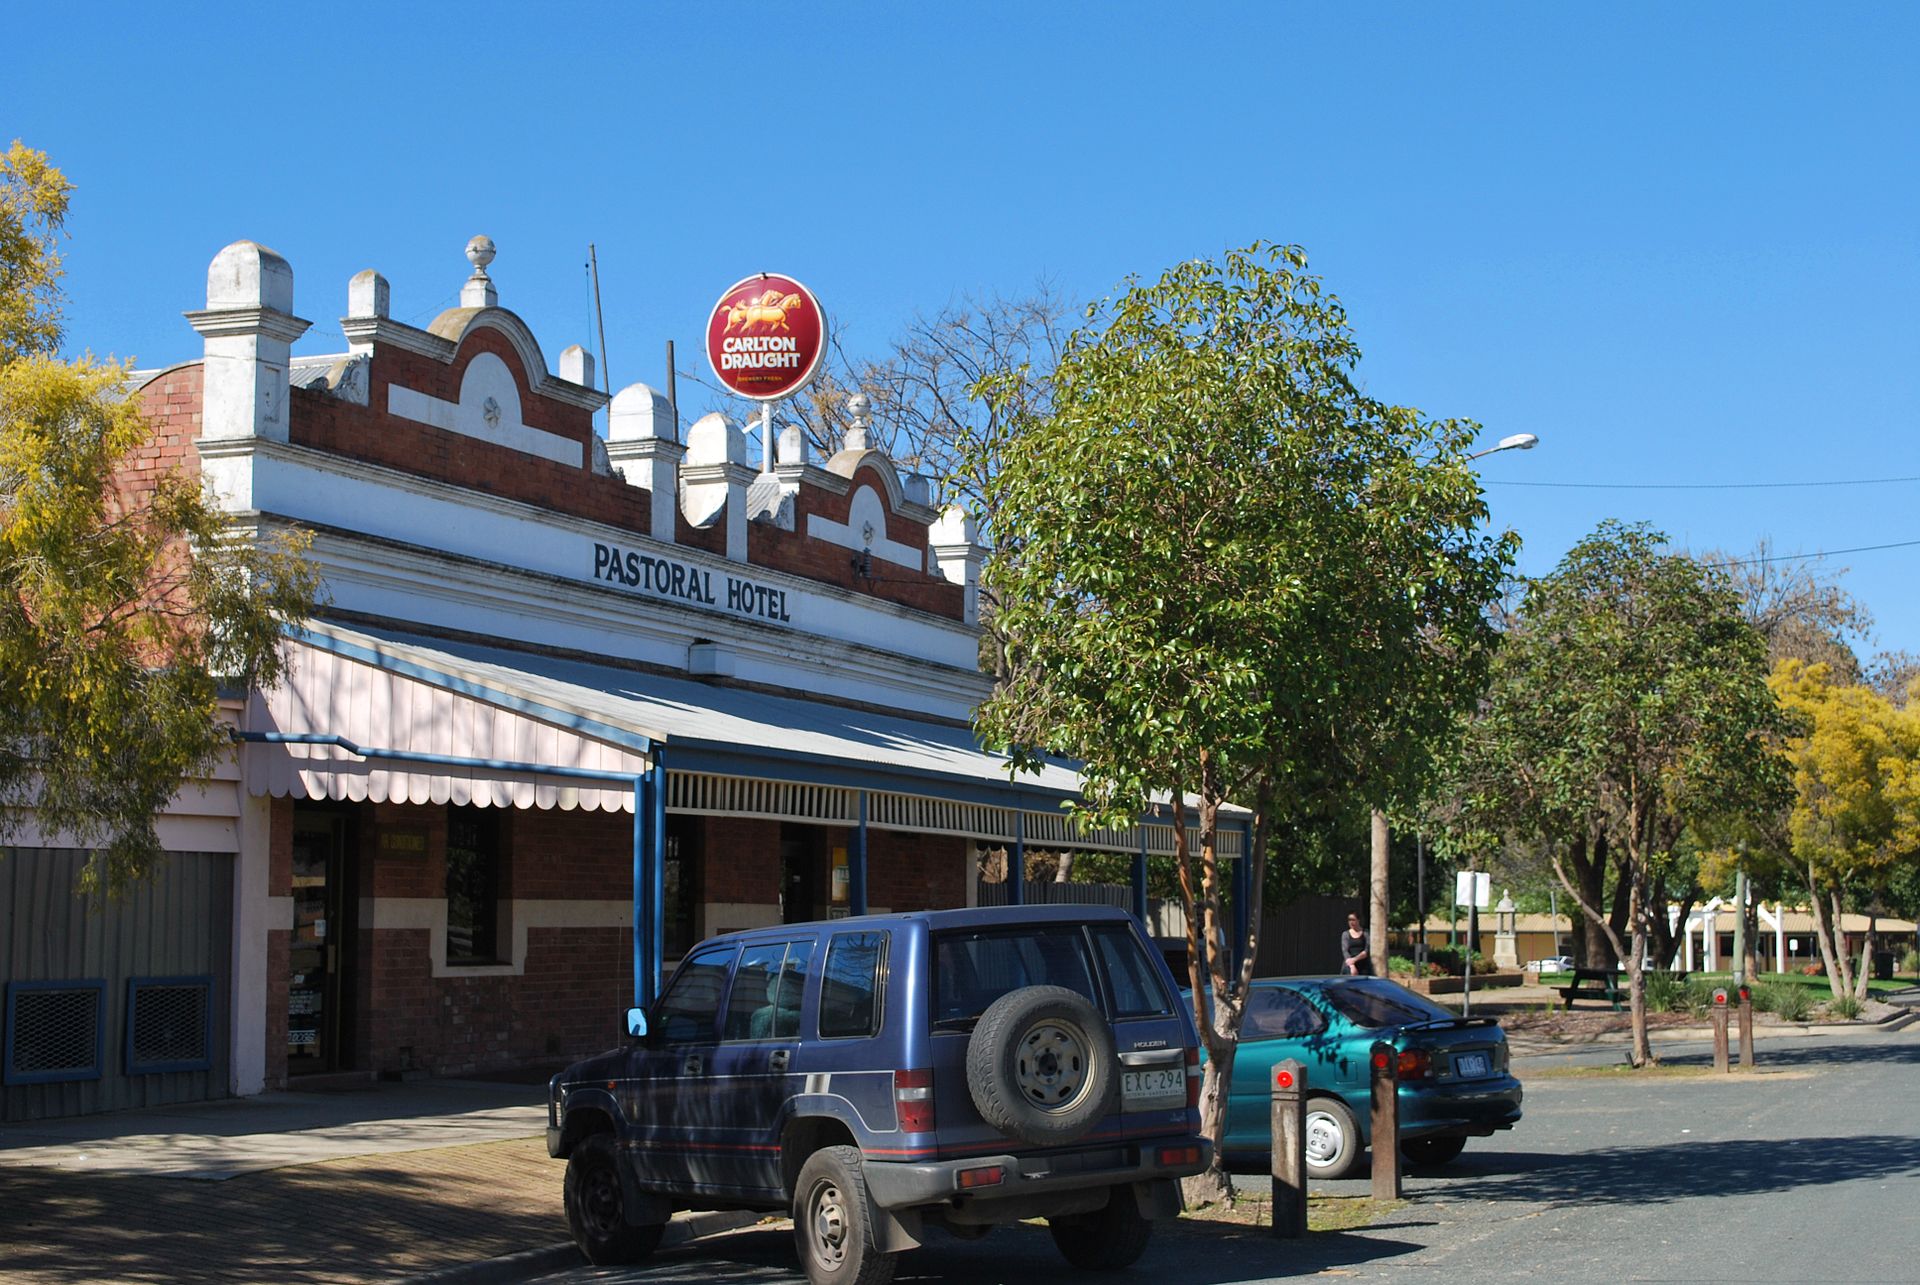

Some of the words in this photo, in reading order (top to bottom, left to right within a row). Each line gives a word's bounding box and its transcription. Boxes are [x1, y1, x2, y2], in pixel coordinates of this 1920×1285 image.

[722, 336, 796, 353] CARLTON
[720, 352, 800, 370] DRAUGHT
[593, 542, 716, 605] PASTORAL
[727, 577, 791, 623] HOTEL
[1133, 1040, 1167, 1049] HOLDEN
[1124, 1071, 1183, 1092] EXC-294
